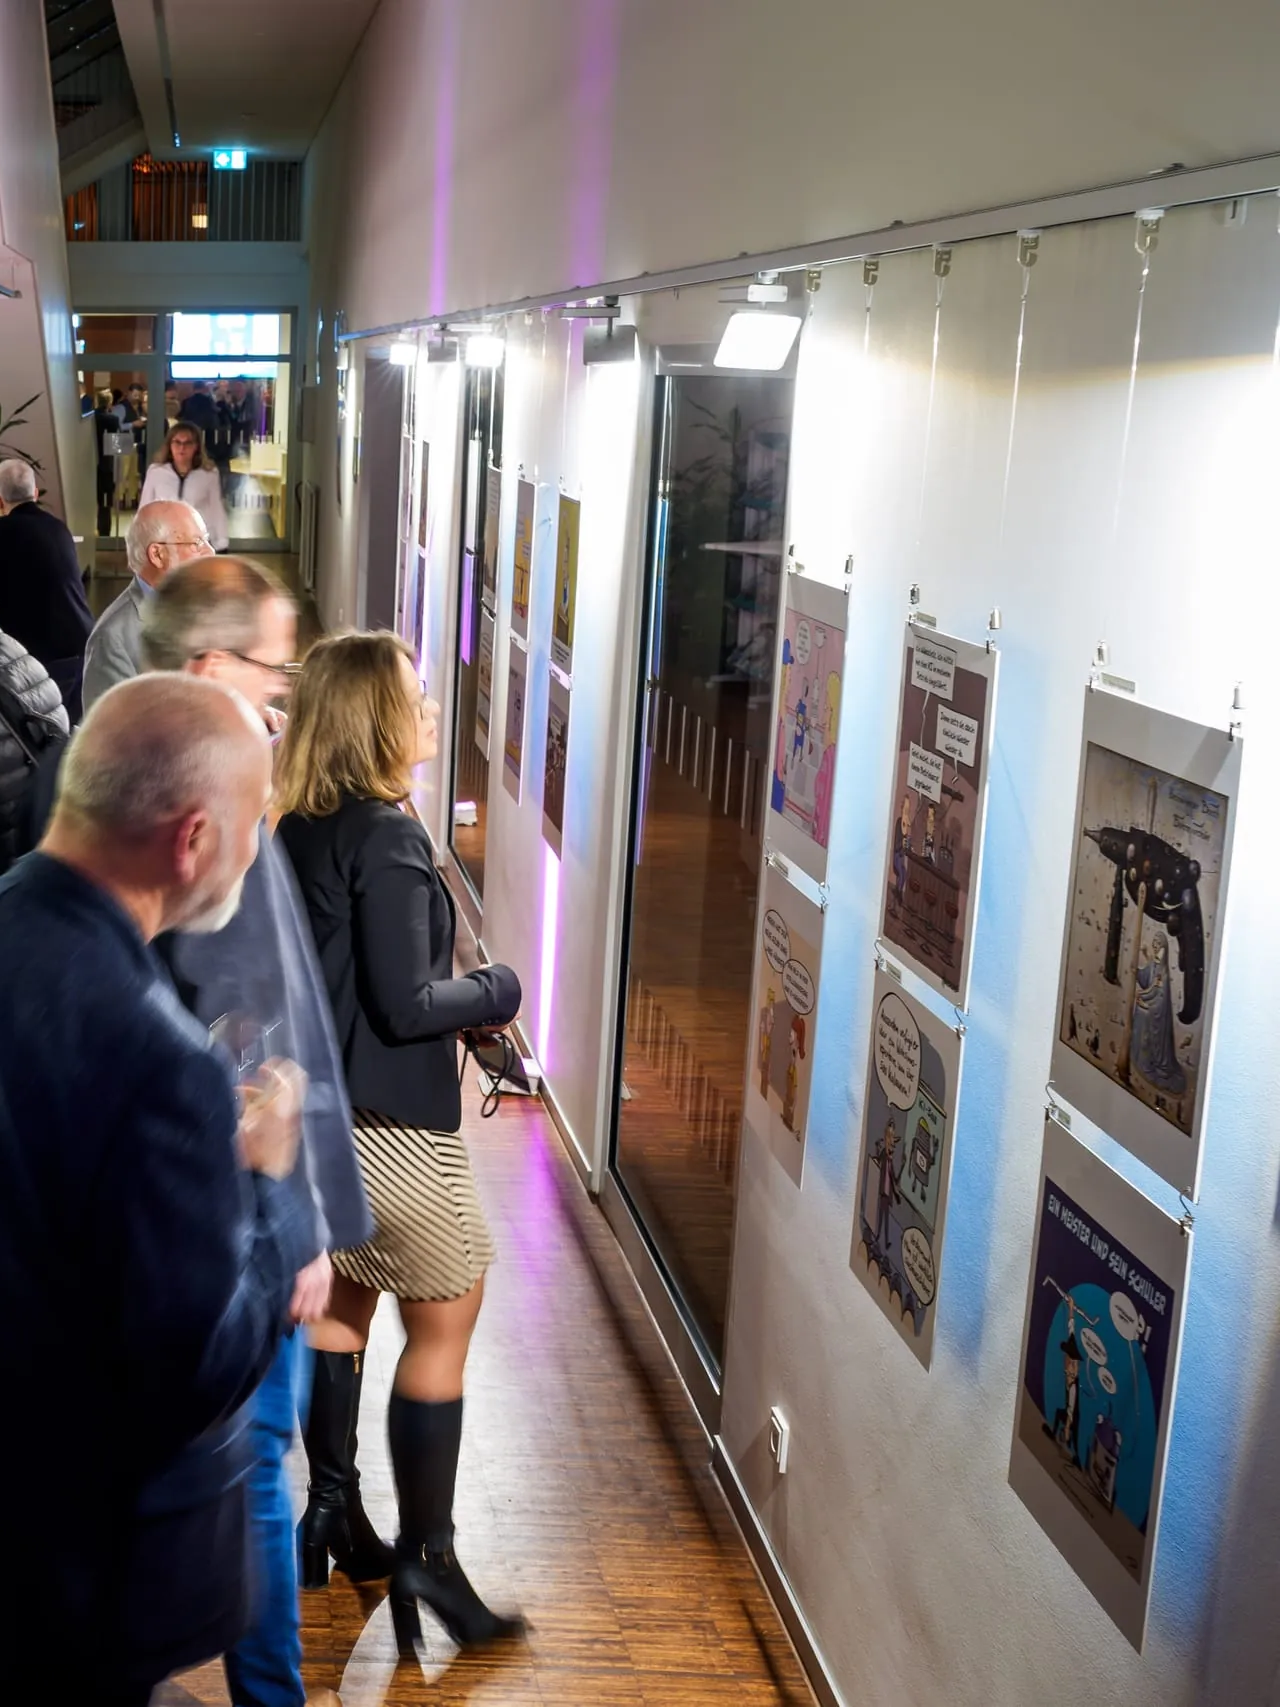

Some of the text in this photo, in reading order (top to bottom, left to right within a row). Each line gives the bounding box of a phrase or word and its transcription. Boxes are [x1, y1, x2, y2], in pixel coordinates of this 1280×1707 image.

[1048, 1194, 1060, 1218] EIN
[1060, 1206, 1091, 1247] MEISTER
[1091, 1234, 1109, 1261] UND
[1108, 1251, 1128, 1280] SEIN
